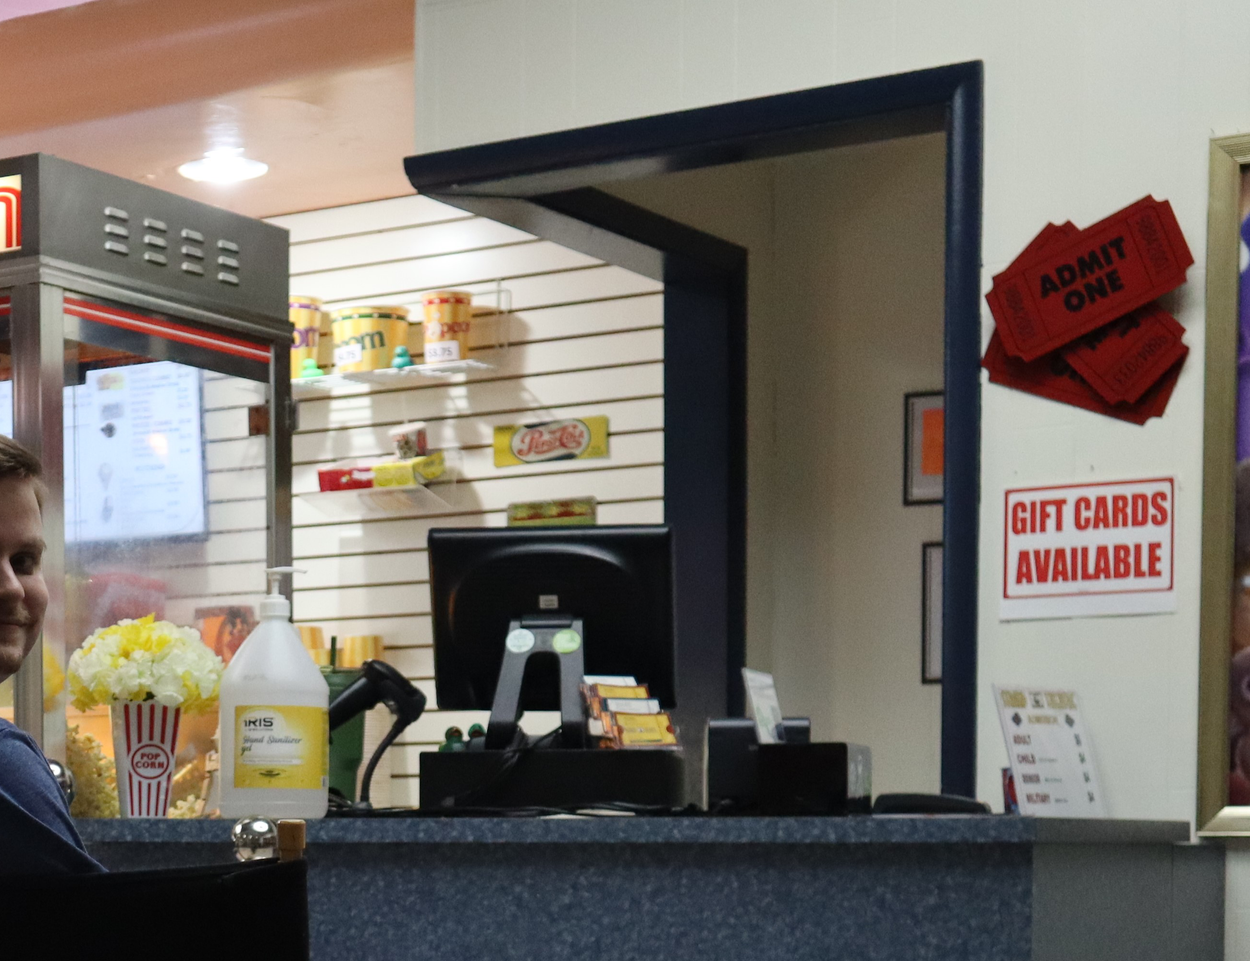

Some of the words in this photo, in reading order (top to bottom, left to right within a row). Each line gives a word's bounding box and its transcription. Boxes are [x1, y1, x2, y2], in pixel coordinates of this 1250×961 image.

[1039, 236, 1127, 299] ADMIT
[1063, 268, 1125, 313] ONE
[1011, 499, 1067, 535] GIFT
[1073, 491, 1169, 532] CARDS
[1014, 542, 1163, 585] AVAILABLE
[139, 752, 162, 762] POP
[242, 735, 265, 745] Hand
[266, 735, 303, 745] Sanitizer
[134, 760, 166, 771] CORN
